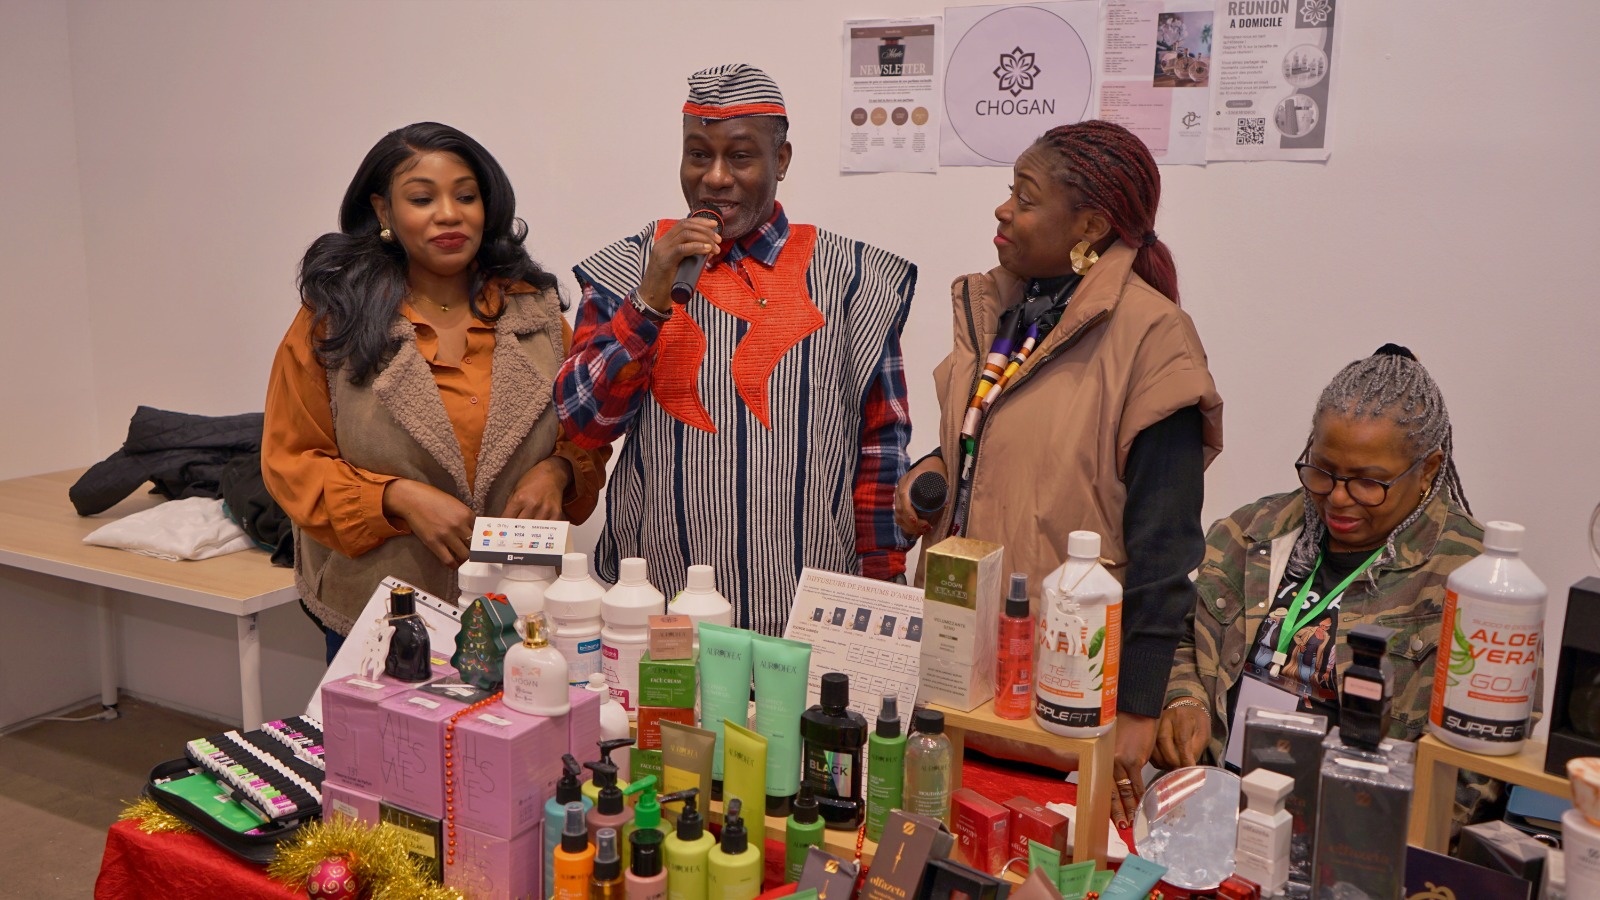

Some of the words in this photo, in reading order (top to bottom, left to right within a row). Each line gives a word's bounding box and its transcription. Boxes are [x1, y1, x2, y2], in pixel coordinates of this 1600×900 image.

[1230, 19, 1236, 28] A
[1239, 17, 1282, 28] DOMICILE
[860, 64, 926, 76] NEWSLETTER
[975, 99, 1055, 116] CHOGAN
[806, 574, 846, 588] DIFFUSEURS
[858, 584, 890, 596] PARFUMS
[1470, 629, 1538, 646] ALOE
[1468, 644, 1535, 664] VERA
[1470, 674, 1528, 692] GOJI
[810, 759, 848, 776] BLACK
[870, 876, 906, 897] olfazeta
